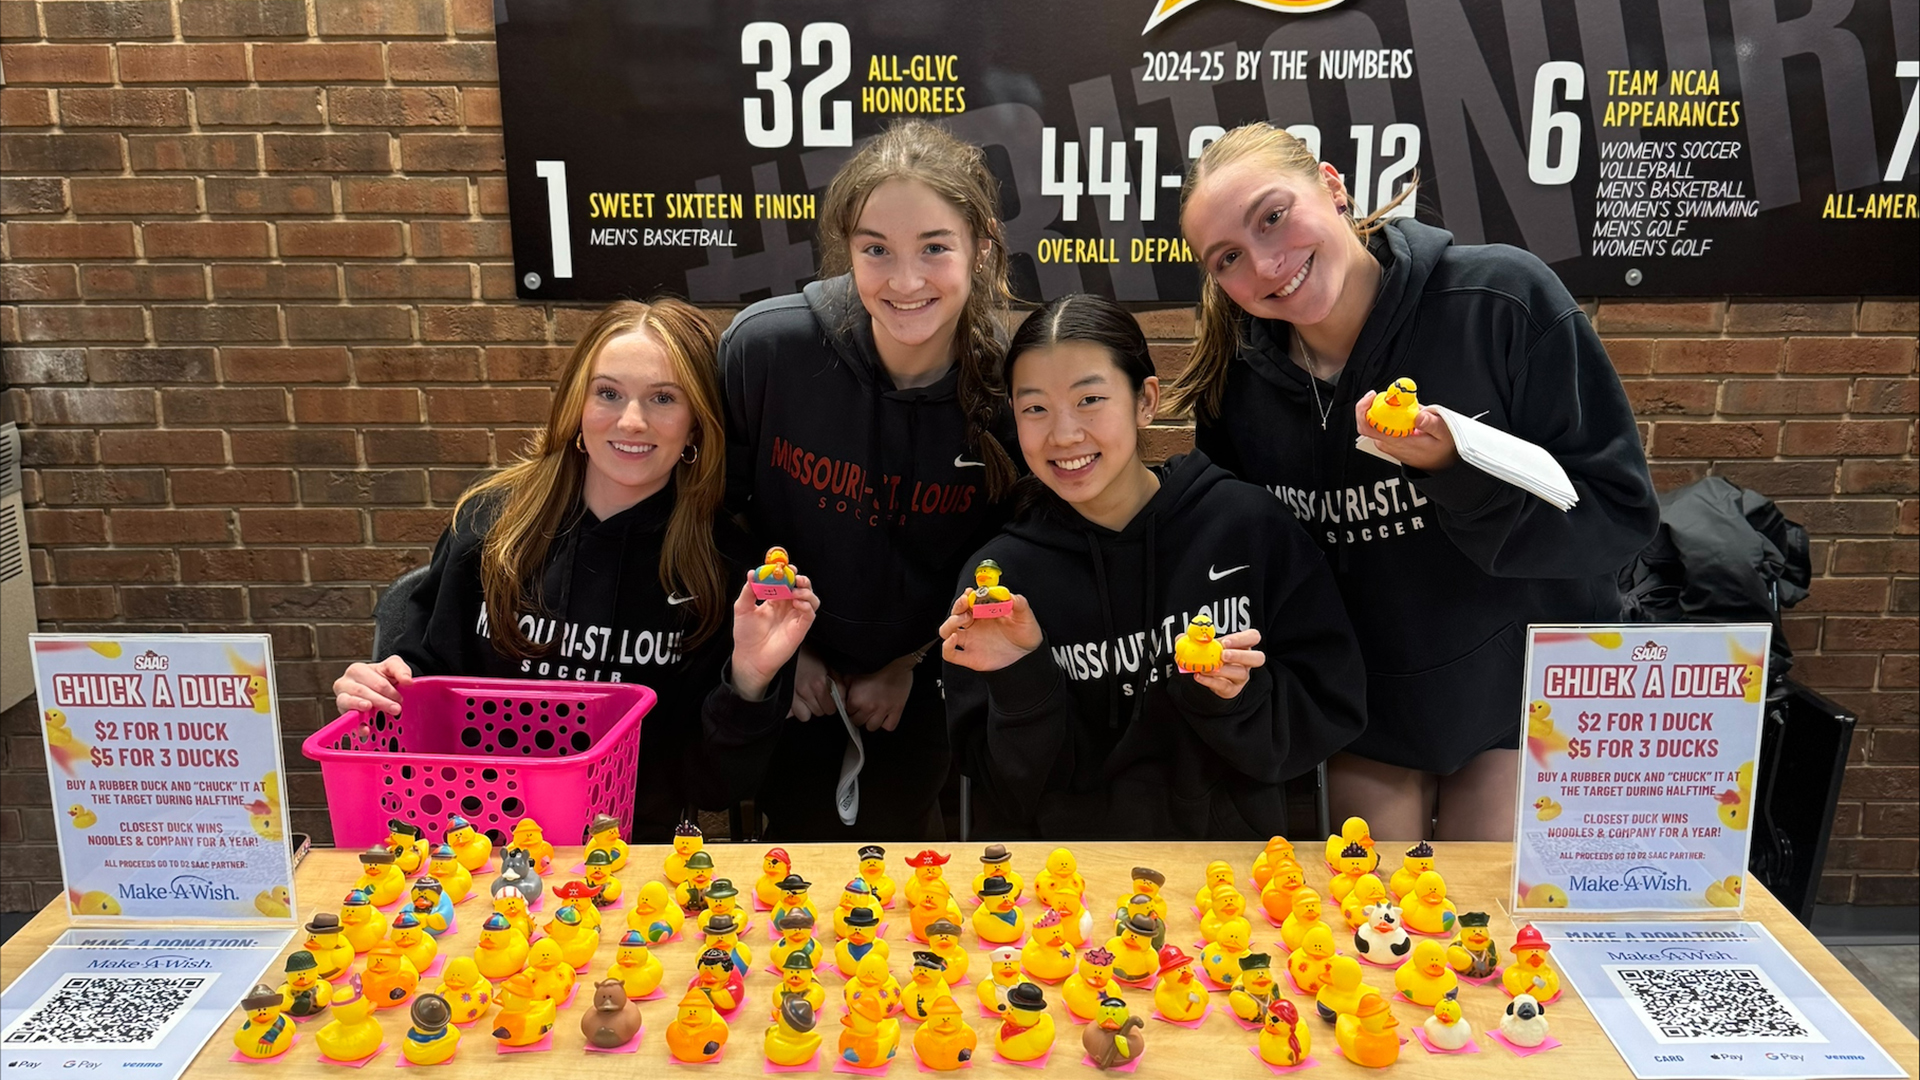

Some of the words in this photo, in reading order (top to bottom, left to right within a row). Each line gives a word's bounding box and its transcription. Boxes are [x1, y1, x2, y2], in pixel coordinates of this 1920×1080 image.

[868, 55, 958, 81] ALL-GLVC
[1142, 51, 1224, 81] 2024-25
[1236, 51, 1260, 80] BY
[1271, 50, 1307, 79] THE
[1319, 48, 1413, 79] NUMBERS
[741, 21, 853, 148] 32
[1607, 70, 1658, 96] TEAM
[1670, 69, 1719, 96] NCAA
[862, 87, 965, 114] HONOREES
[1528, 60, 1585, 185] 6
[1603, 100, 1740, 127] APPEARANCES
[1601, 141, 1677, 159] WOMEN'S
[1680, 141, 1741, 159] SOCCER
[1600, 161, 1694, 179] VOLLEYBALL
[1596, 181, 1646, 199] MEN'S
[1650, 181, 1745, 199] BASKETBALL
[589, 192, 655, 218] SWEET
[666, 193, 743, 219] SIXTEEN
[755, 194, 815, 219] FINISH
[1596, 201, 1671, 218] WOMEN'S
[1675, 200, 1760, 217] SWIMMING
[1821, 193, 1919, 219] ALL-AMER
[536, 161, 572, 278] 1
[1592, 220, 1643, 237] MEN'S
[1646, 220, 1688, 237] GOLF
[590, 228, 638, 246] MEN'S
[643, 228, 737, 247] BASKETBALL
[1037, 238, 1119, 263] OVERALL
[1592, 239, 1667, 257] WOMEN'S
[1671, 239, 1713, 257] GOLF
[911, 481, 976, 514] LOUIS
[1632, 646, 1668, 661] SAAC
[135, 656, 169, 670] SAAC
[1545, 666, 1637, 698] CHUCK
[1642, 666, 1664, 698] A
[1671, 665, 1746, 698] DUCK
[54, 675, 145, 706] CHUCK
[154, 675, 174, 706] A
[178, 675, 254, 707] DUCK
[95, 720, 119, 741] $2
[123, 722, 159, 740] FOR
[164, 722, 172, 740] 1
[178, 722, 228, 741] DUCK
[1578, 711, 1601, 732] $2
[1607, 713, 1643, 731] FOR
[1649, 713, 1657, 731] 1
[1662, 713, 1714, 731] DUCK
[90, 746, 113, 767] $5
[119, 748, 154, 766] FOR
[161, 749, 171, 766] 3
[177, 748, 239, 767] DUCKS
[1568, 738, 1591, 759] $5
[1597, 740, 1633, 758] FOR
[1639, 739, 1650, 757] 3
[1656, 739, 1719, 758] DUCKS
[67, 780, 86, 791] BUY
[90, 781, 97, 790] A
[100, 781, 138, 791] RUBBER
[141, 781, 168, 791] DUCK
[171, 781, 191, 791] AND
[194, 781, 237, 792] “CHUCK”
[241, 782, 250, 792] IT
[253, 782, 266, 792] AT
[1537, 772, 1558, 782] BUY
[1560, 772, 1568, 782] A
[1570, 772, 1611, 782] RUBBER
[1613, 772, 1641, 782] DUCK
[1644, 772, 1665, 782] AND
[1668, 772, 1712, 782] “CHUCK”
[1714, 772, 1724, 782] IT
[1727, 772, 1741, 782] AT
[91, 794, 111, 804] THE
[113, 794, 152, 804] TARGET
[156, 795, 193, 805] DURING
[1561, 786, 1580, 796] THE
[1582, 786, 1623, 796] TARGET
[1626, 786, 1663, 796] DURING
[120, 822, 164, 833] CLOSEST
[168, 822, 193, 833] DUCK
[196, 823, 223, 833] WINS
[1583, 813, 1628, 824] CLOSEST
[1632, 813, 1658, 824] DUCK
[1662, 813, 1688, 824] WINS
[88, 835, 132, 846] NOODLES
[135, 836, 144, 846] &
[147, 836, 193, 846] COMPANY
[197, 837, 216, 847] FOR
[219, 837, 226, 847] A
[229, 837, 259, 847] YEAR!
[1548, 828, 1594, 838] NOODLES
[1597, 828, 1605, 838] &
[1609, 828, 1656, 838] COMPANY
[1659, 828, 1679, 838] FOR
[1681, 828, 1688, 838] A
[1691, 827, 1721, 838] YEAR!
[119, 860, 156, 868] PROCEEDS
[158, 860, 168, 868] GO
[169, 860, 179, 868] TO
[211, 861, 248, 869] PARTNER:
[1575, 852, 1613, 860] PROCEEDS
[1669, 852, 1706, 860] PARTNER:
[78, 939, 135, 950] MAKE
[134, 939, 150, 950] A
[1564, 932, 1621, 942] MAKE
[1625, 932, 1637, 942] A
[1641, 932, 1748, 942] DONATION:
[17, 1060, 42, 1069] Pay
[78, 1060, 102, 1070] Pay
[1654, 1055, 1685, 1063] CARD
[1720, 1053, 1743, 1062] Pay
[1780, 1053, 1805, 1062] Pay
